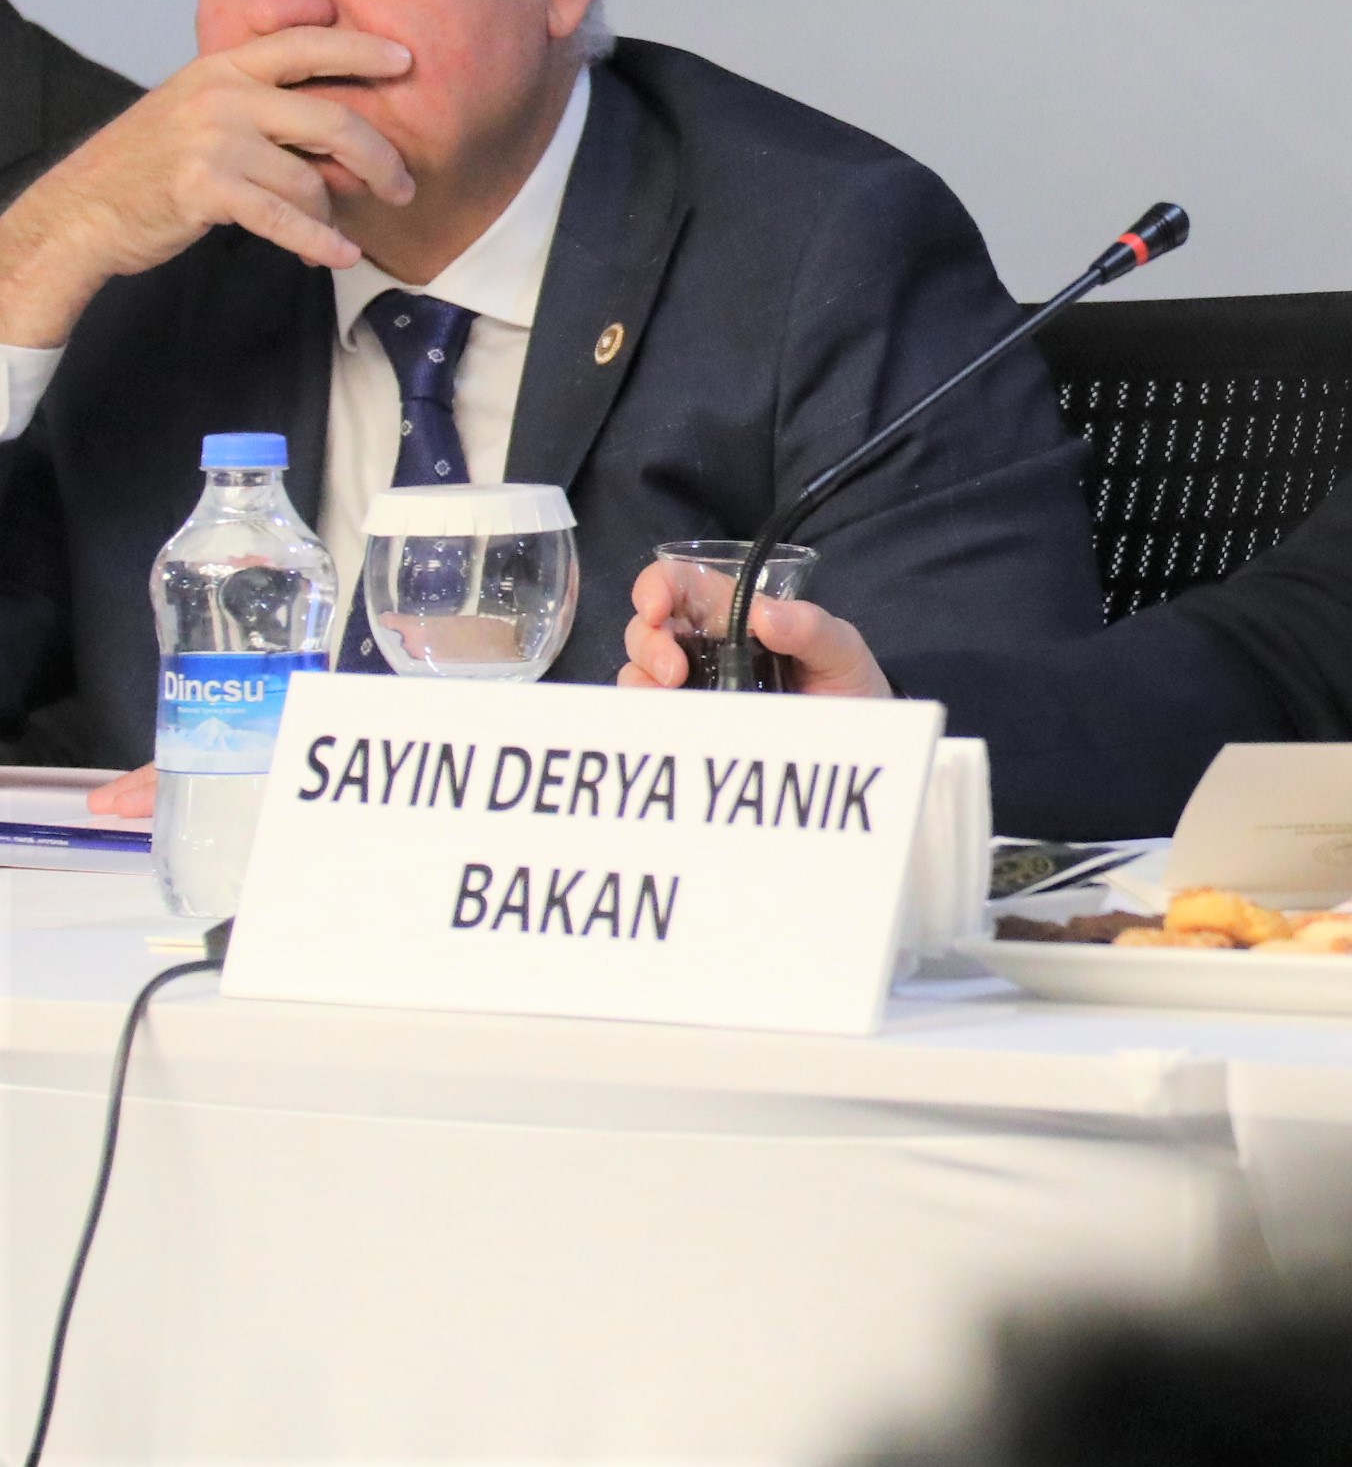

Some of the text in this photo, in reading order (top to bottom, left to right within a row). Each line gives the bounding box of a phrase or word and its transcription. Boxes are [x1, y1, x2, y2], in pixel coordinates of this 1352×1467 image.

[164, 671, 265, 705] Dinçsu
[298, 734, 883, 833] SAYIN DERYA YANIK
[450, 863, 680, 942] BAKAN
